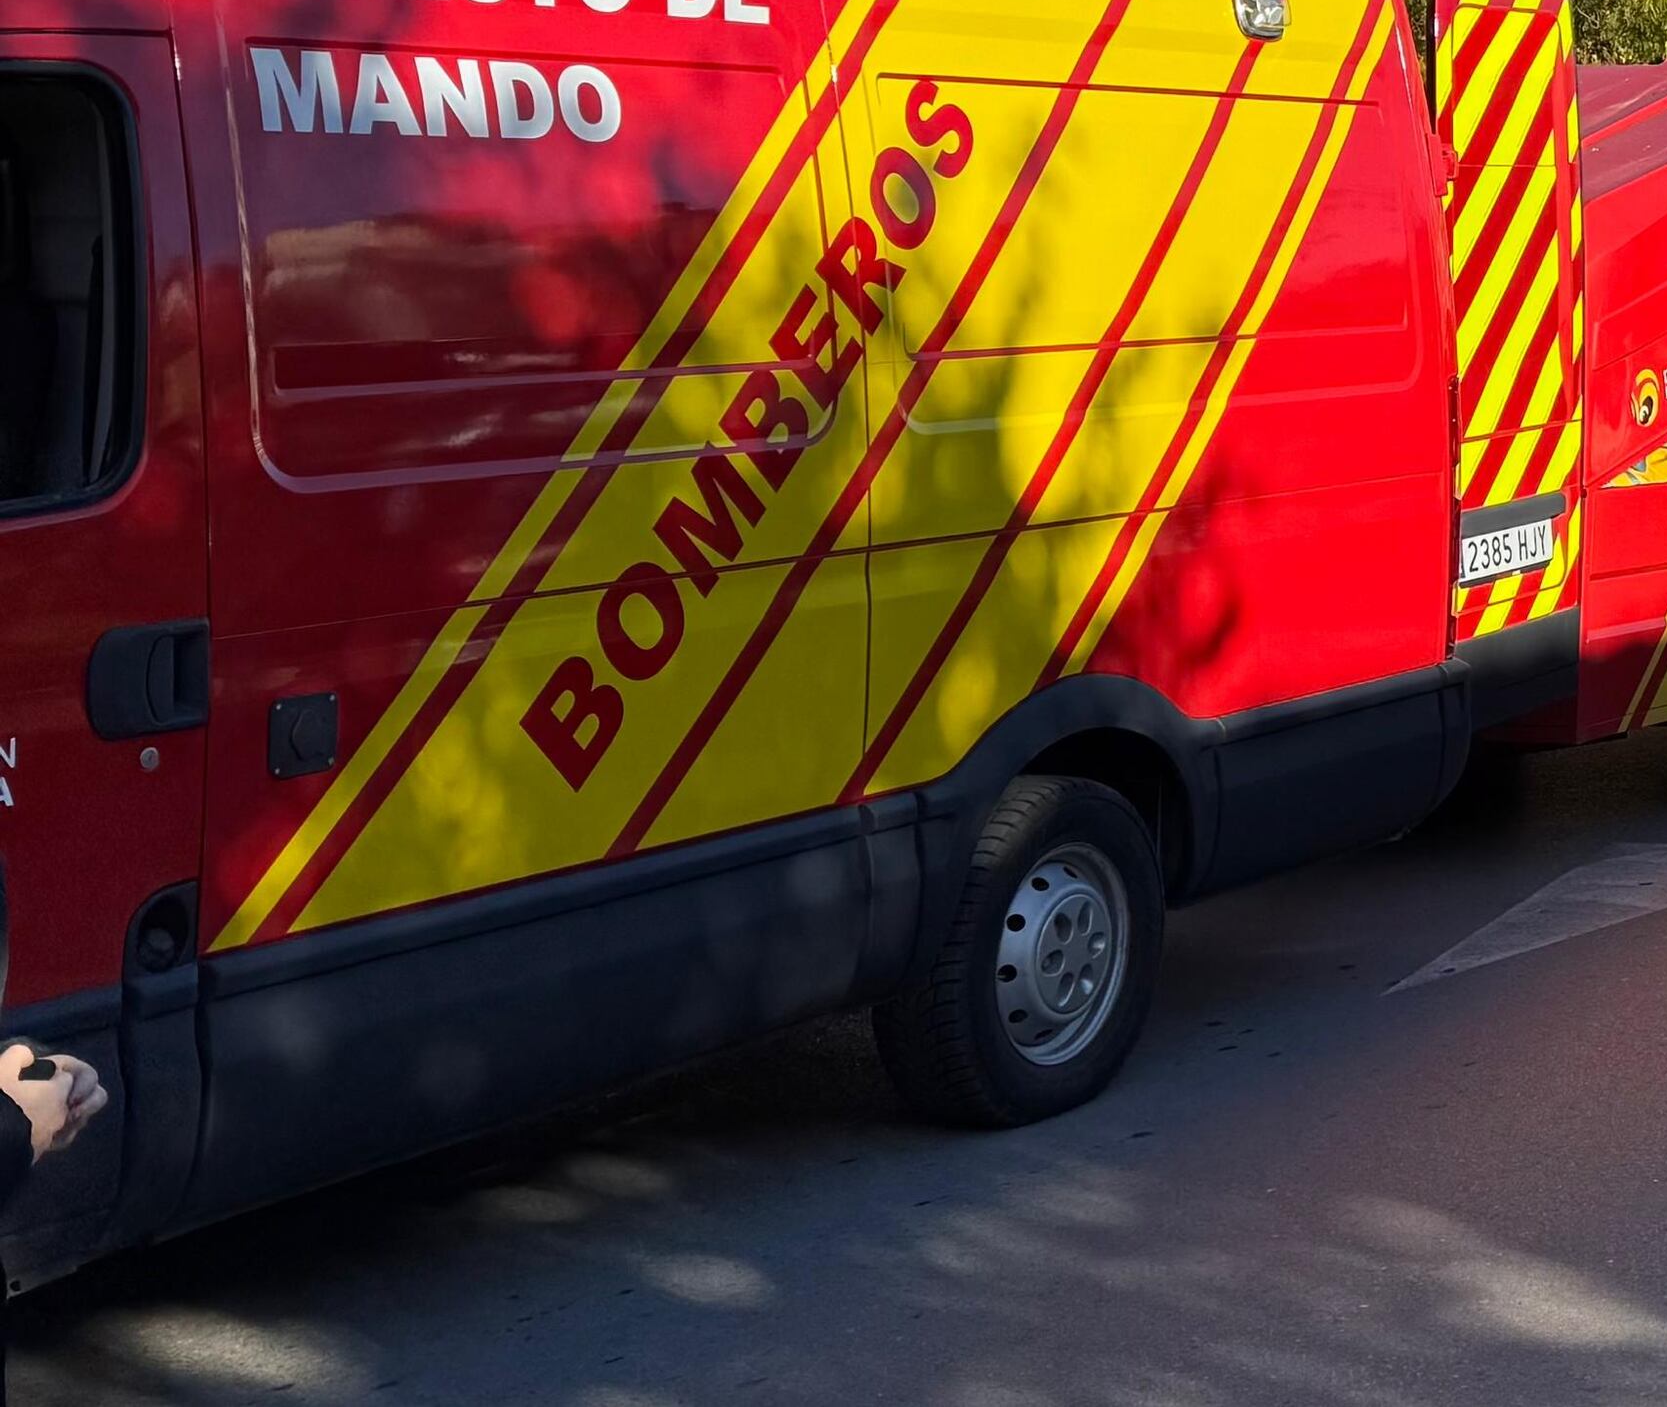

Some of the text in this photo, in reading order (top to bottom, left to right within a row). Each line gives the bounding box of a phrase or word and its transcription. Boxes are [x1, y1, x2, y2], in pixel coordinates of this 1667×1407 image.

[250, 47, 622, 143] MANDO
[520, 79, 975, 793] BOMBEROS
[1468, 525, 1546, 573] 2385 HJY
